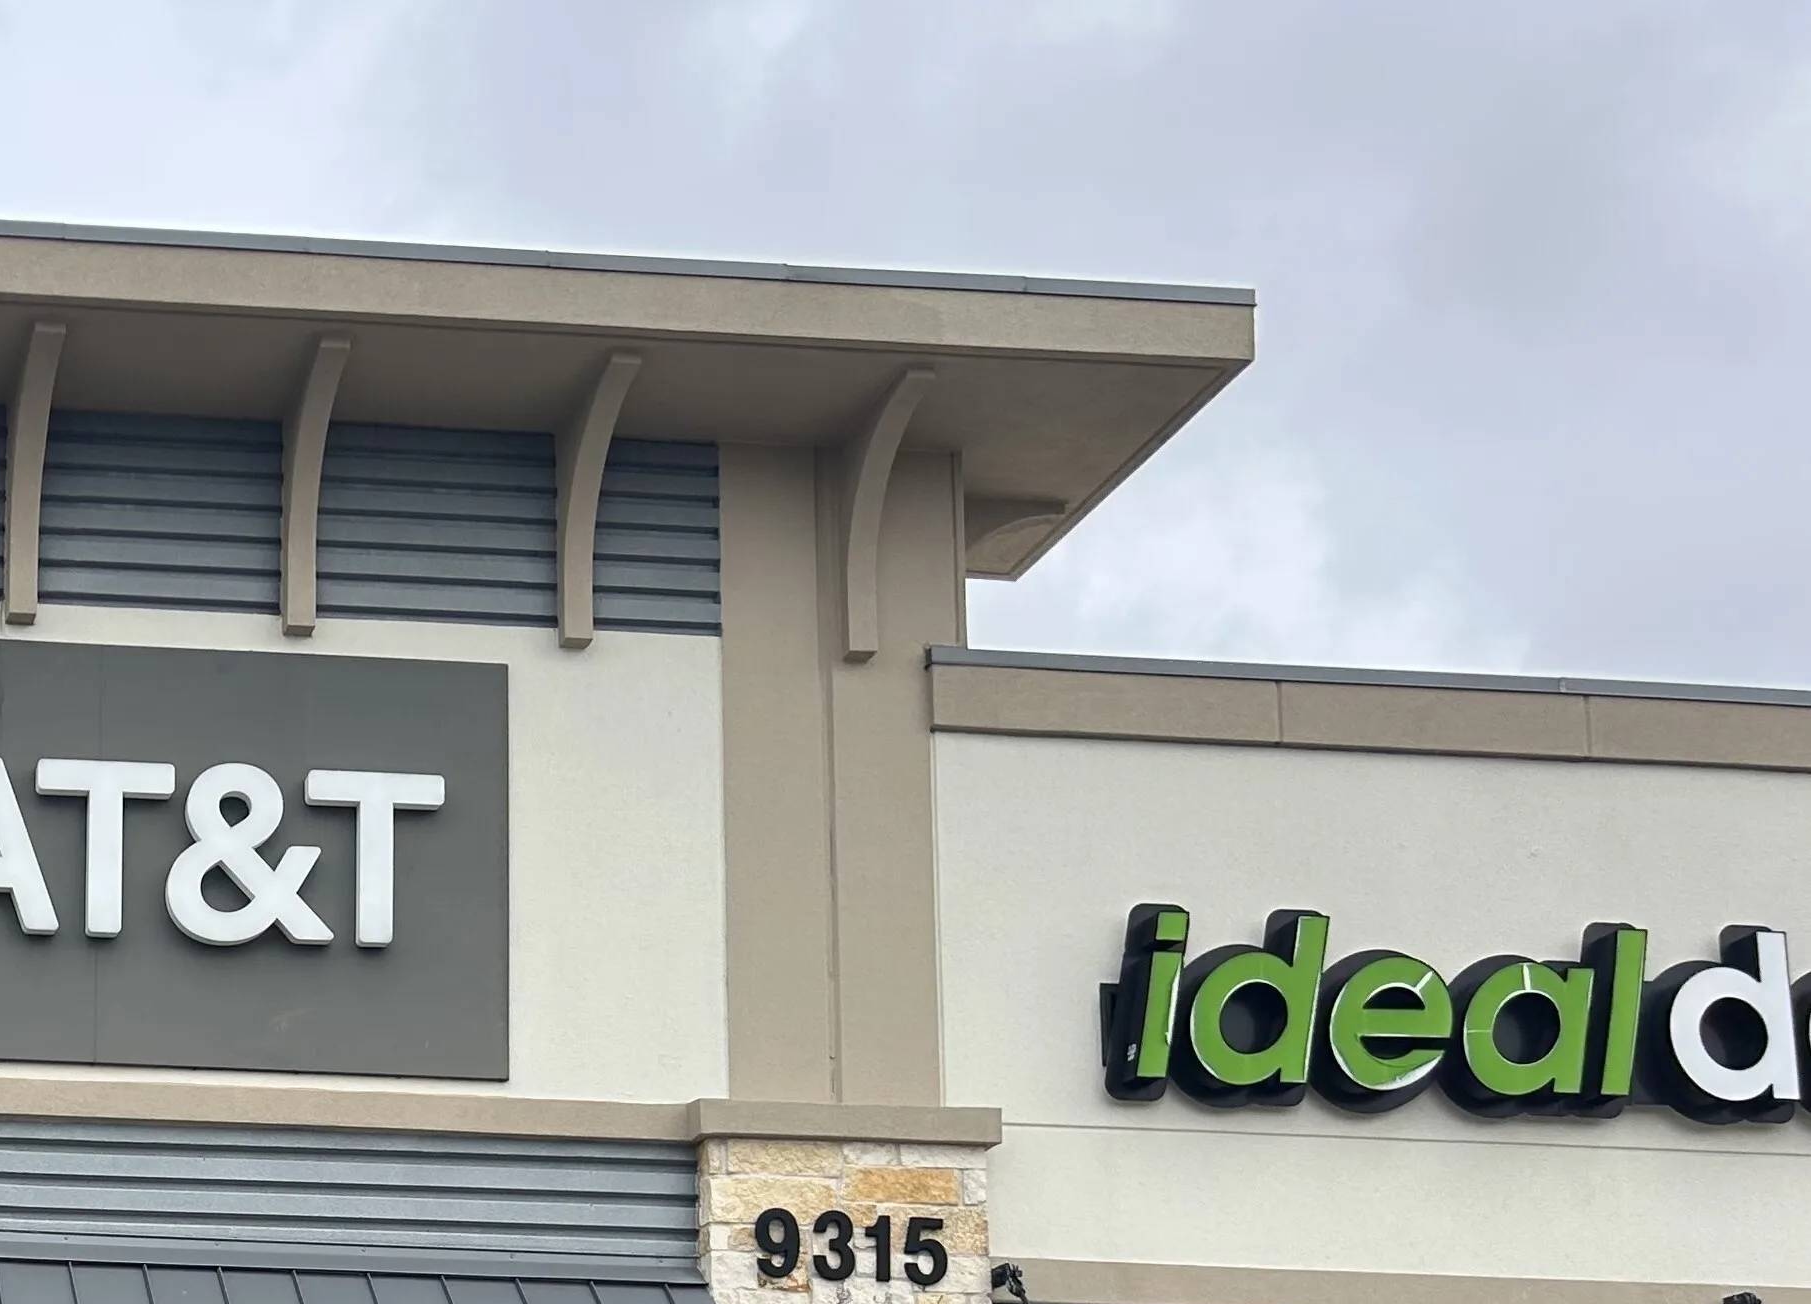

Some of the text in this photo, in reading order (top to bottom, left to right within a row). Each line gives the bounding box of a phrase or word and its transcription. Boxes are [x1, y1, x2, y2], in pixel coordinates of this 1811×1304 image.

[1135, 910, 1811, 1101] ideal d
[755, 1207, 948, 1286] 9315
